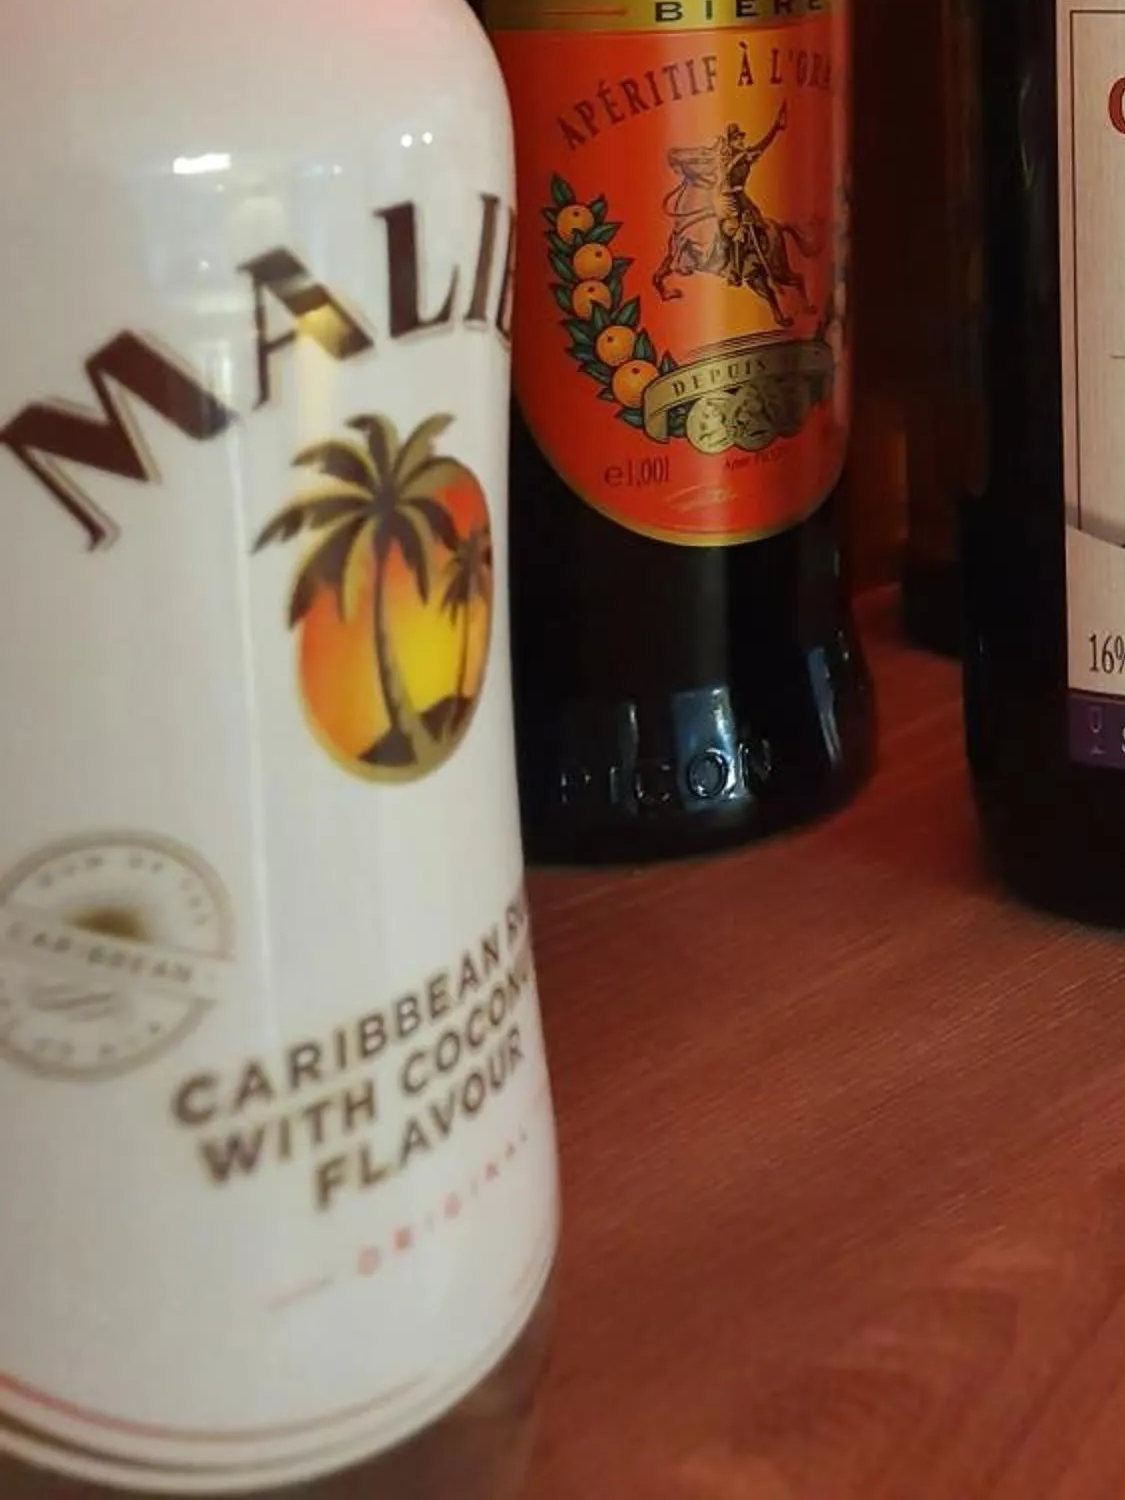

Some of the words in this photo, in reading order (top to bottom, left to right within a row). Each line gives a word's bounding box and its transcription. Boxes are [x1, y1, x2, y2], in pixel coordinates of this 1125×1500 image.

[556, 55, 718, 151] APÉRITIF
[738, 41, 754, 87] À
[0, 193, 517, 553] MALI
[172, 918, 502, 1127] CARIBBEAN
[200, 1078, 376, 1188] WITH
[316, 1027, 525, 1212] FLAVOUR
